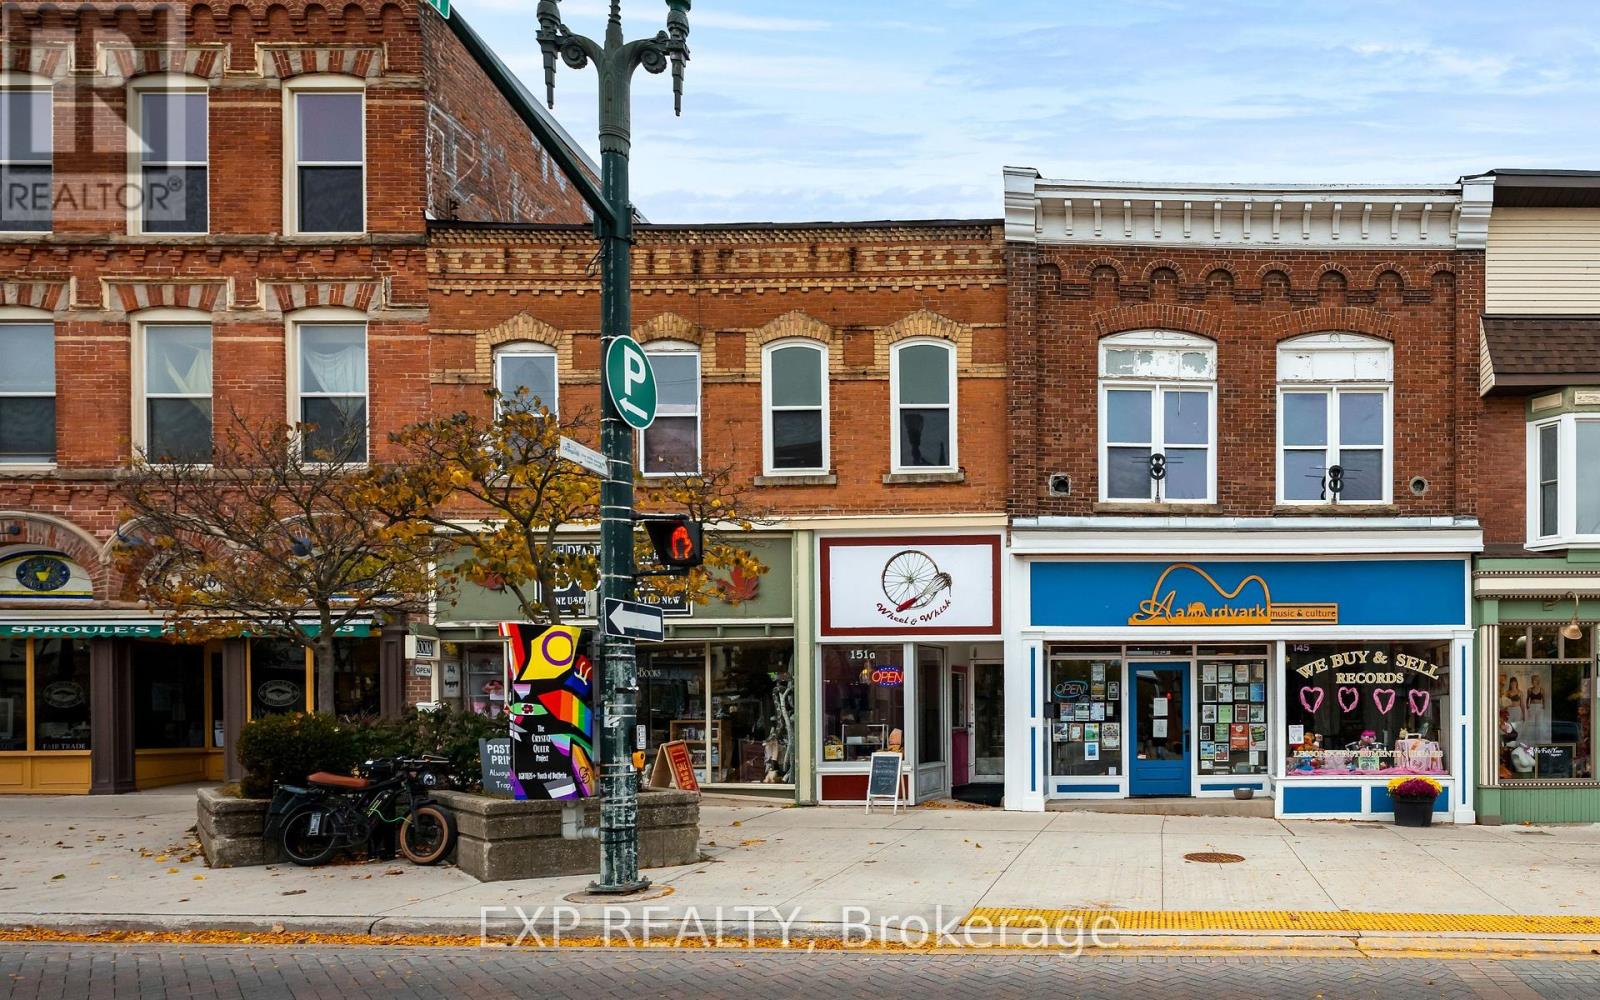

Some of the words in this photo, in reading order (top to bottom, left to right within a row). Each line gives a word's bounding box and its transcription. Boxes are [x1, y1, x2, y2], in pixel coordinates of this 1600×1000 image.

[624, 345, 646, 396] P
[876, 602, 909, 624] Wheel
[910, 617, 917, 625] &
[919, 599, 951, 622] Whisk
[1271, 609, 1295, 617] music
[1297, 609, 1303, 617] &
[1305, 608, 1336, 618] culture
[10, 625, 150, 634] SPROULE'S
[850, 649, 876, 659] 151a
[1293, 644, 1310, 652] 145
[1296, 658, 1328, 679] WE
[1329, 650, 1370, 669] BUY
[1373, 651, 1388, 664] &
[1396, 653, 1440, 680] SELL
[872, 670, 904, 682] OPEN
[1336, 672, 1404, 684] RECORDS
[1055, 683, 1086, 695] OPEN
[487, 744, 510, 754] PAST
